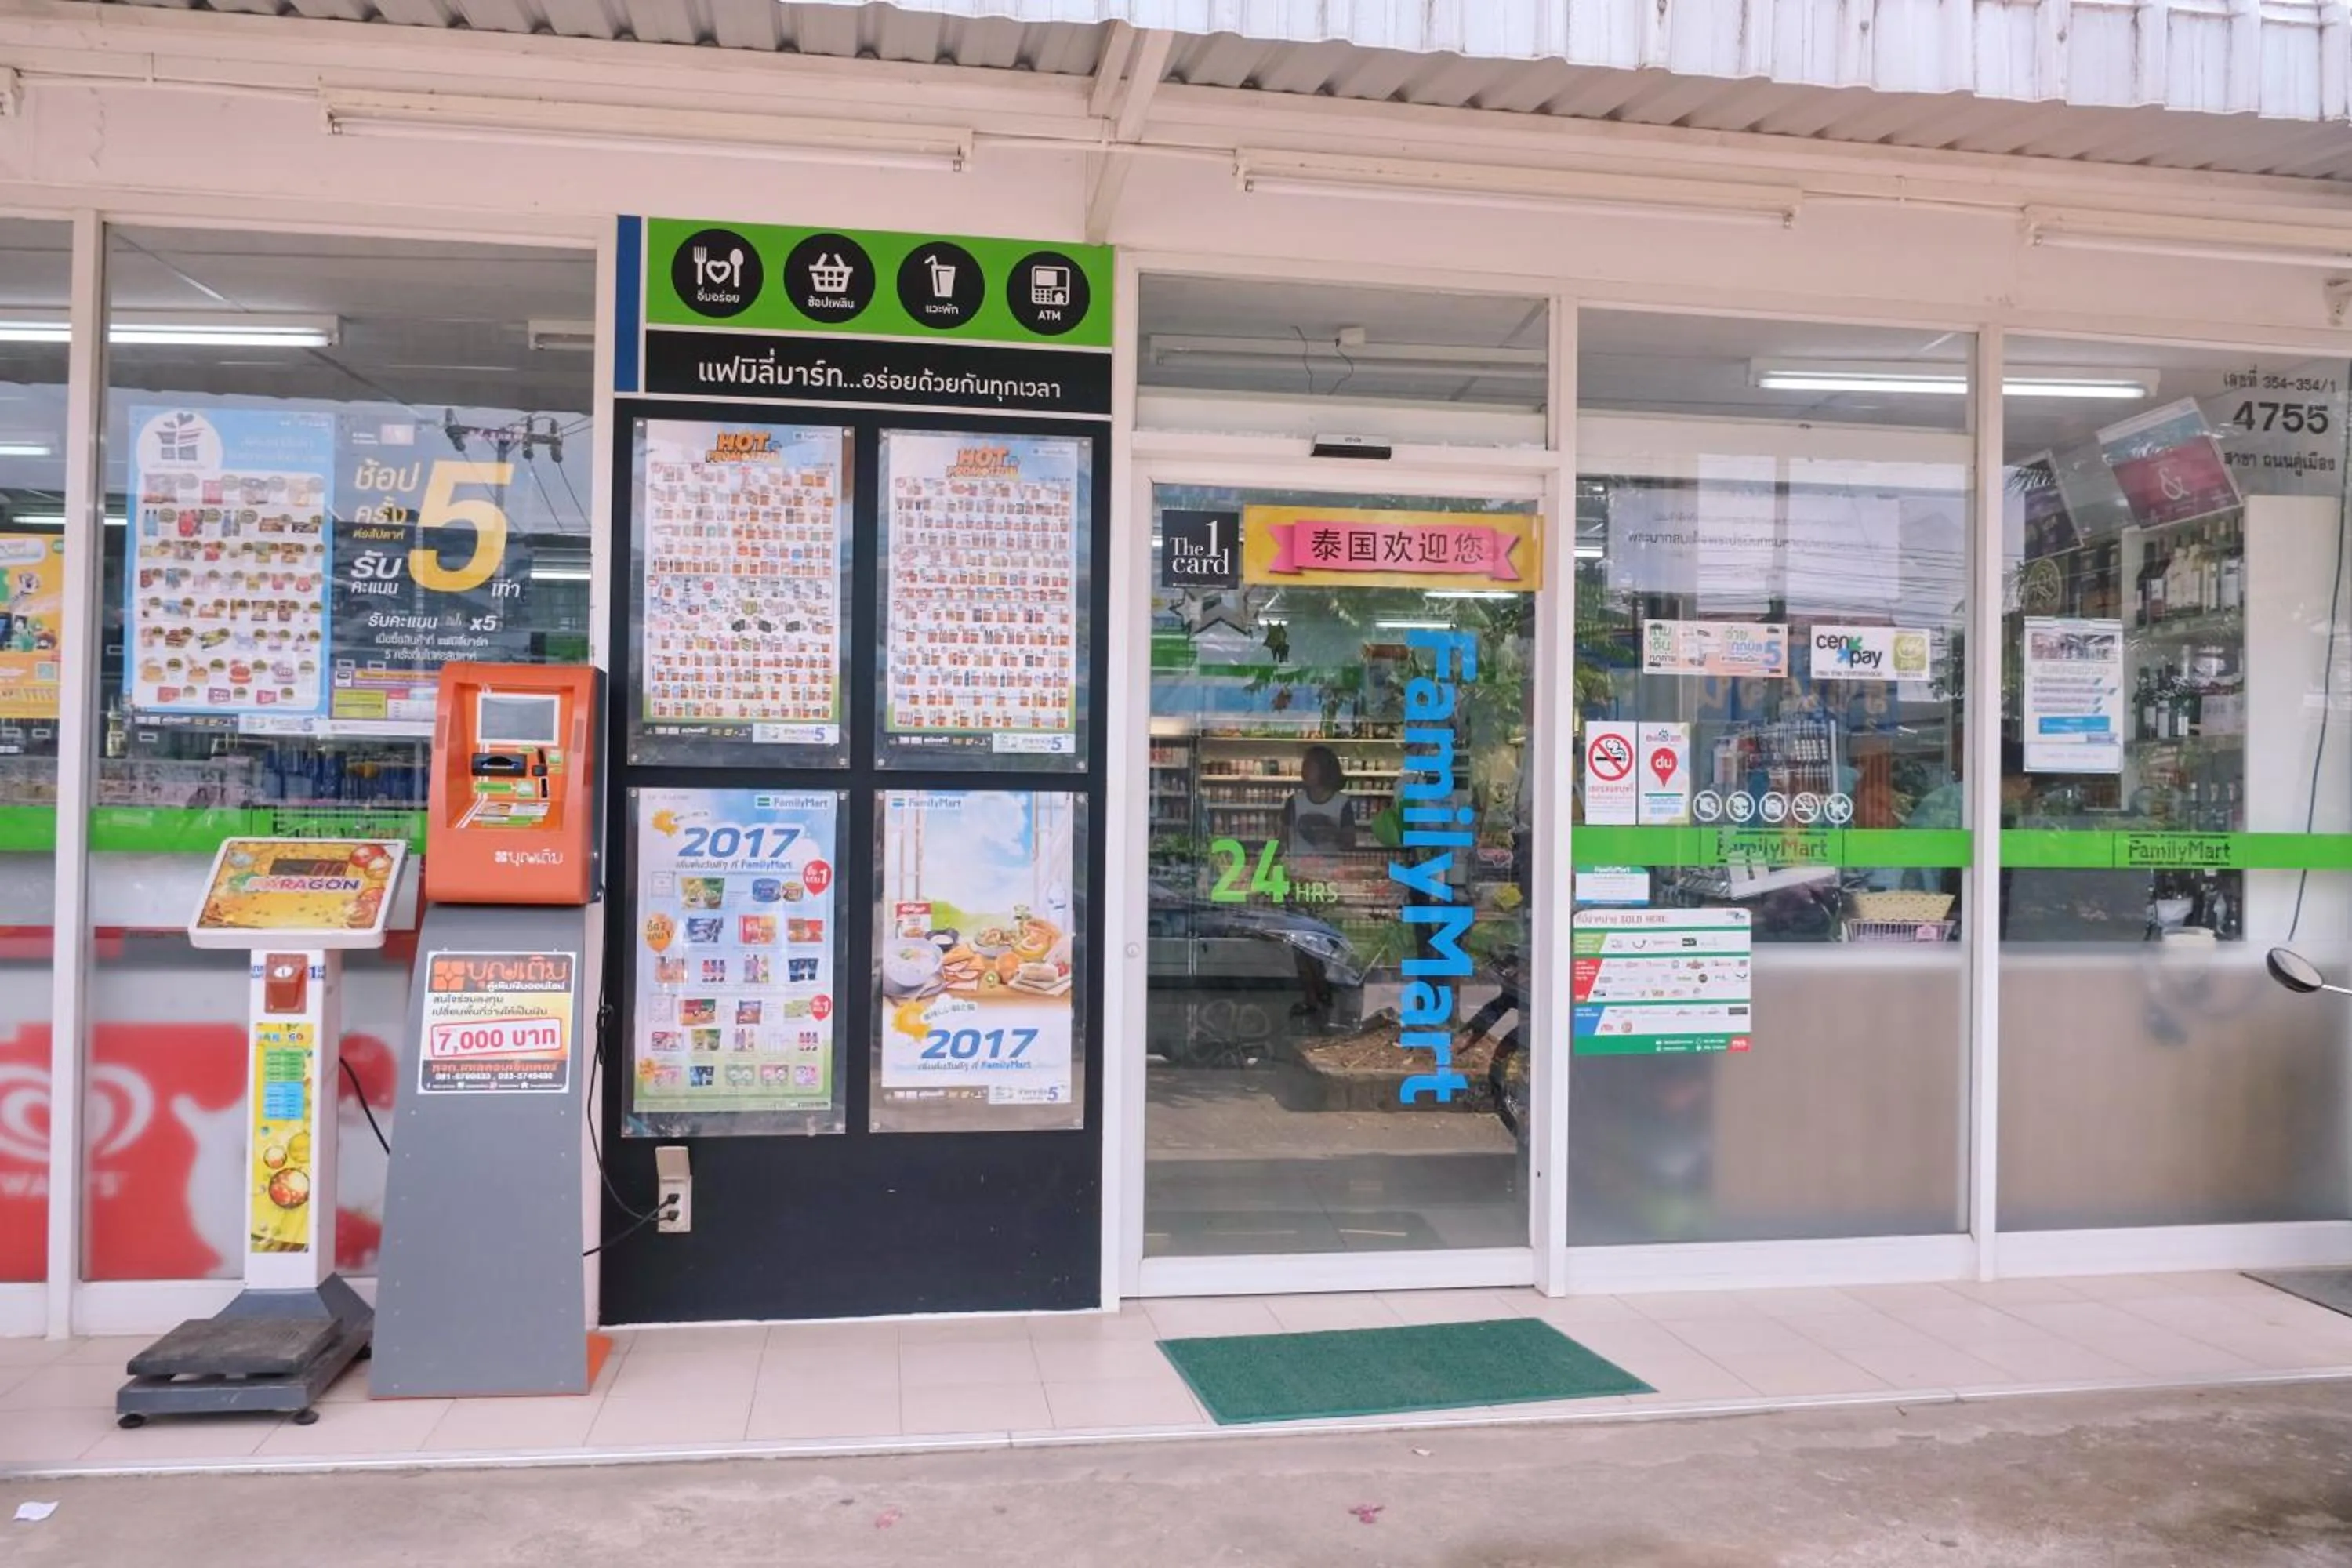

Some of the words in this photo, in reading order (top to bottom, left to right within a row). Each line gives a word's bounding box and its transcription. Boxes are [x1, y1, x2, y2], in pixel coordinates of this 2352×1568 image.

[696, 287, 740, 303] อิ่มอร่อย
[925, 303, 959, 314] แวะพัก
[1037, 310, 1062, 321] ATM
[2223, 364, 2258, 388] เลขที่
[2263, 375, 2336, 394] 354-354/1
[2232, 401, 2328, 434] 4755
[716, 431, 771, 452] HOT
[957, 446, 1010, 467] HOT
[2223, 452, 2257, 466] สาขา
[354, 458, 421, 492] ช้อป
[408, 459, 515, 593] 5
[1169, 536, 1204, 556] The
[1206, 520, 1221, 557] 1
[1311, 529, 1484, 564] 泰国欢迎您
[350, 550, 402, 579] รับ
[1171, 547, 1230, 575] card
[350, 580, 398, 596] คะแนน
[491, 578, 521, 599] เท่า
[368, 612, 438, 630] รับคะแนน
[470, 615, 497, 632] x5
[1764, 641, 1783, 666] 5
[1849, 650, 1882, 669] pay
[813, 727, 826, 742] 5
[1051, 736, 1062, 751] 5
[1655, 755, 1672, 768] du
[773, 797, 829, 809] FamilyMart
[908, 797, 962, 809] FamilyMart
[677, 827, 801, 858] 2017
[1716, 837, 1828, 862] FamilyMart
[2129, 839, 2230, 862] FamilyMart
[1210, 838, 1290, 904] 24
[1295, 882, 1338, 902] HRS
[1388, 629, 1479, 1105] FamilyMart
[467, 954, 567, 988] บุญเติม
[437, 1028, 504, 1054] 7,000
[512, 1028, 556, 1047] บาท
[920, 1028, 1039, 1059] 2017
[1047, 1087, 1058, 1101] 5
